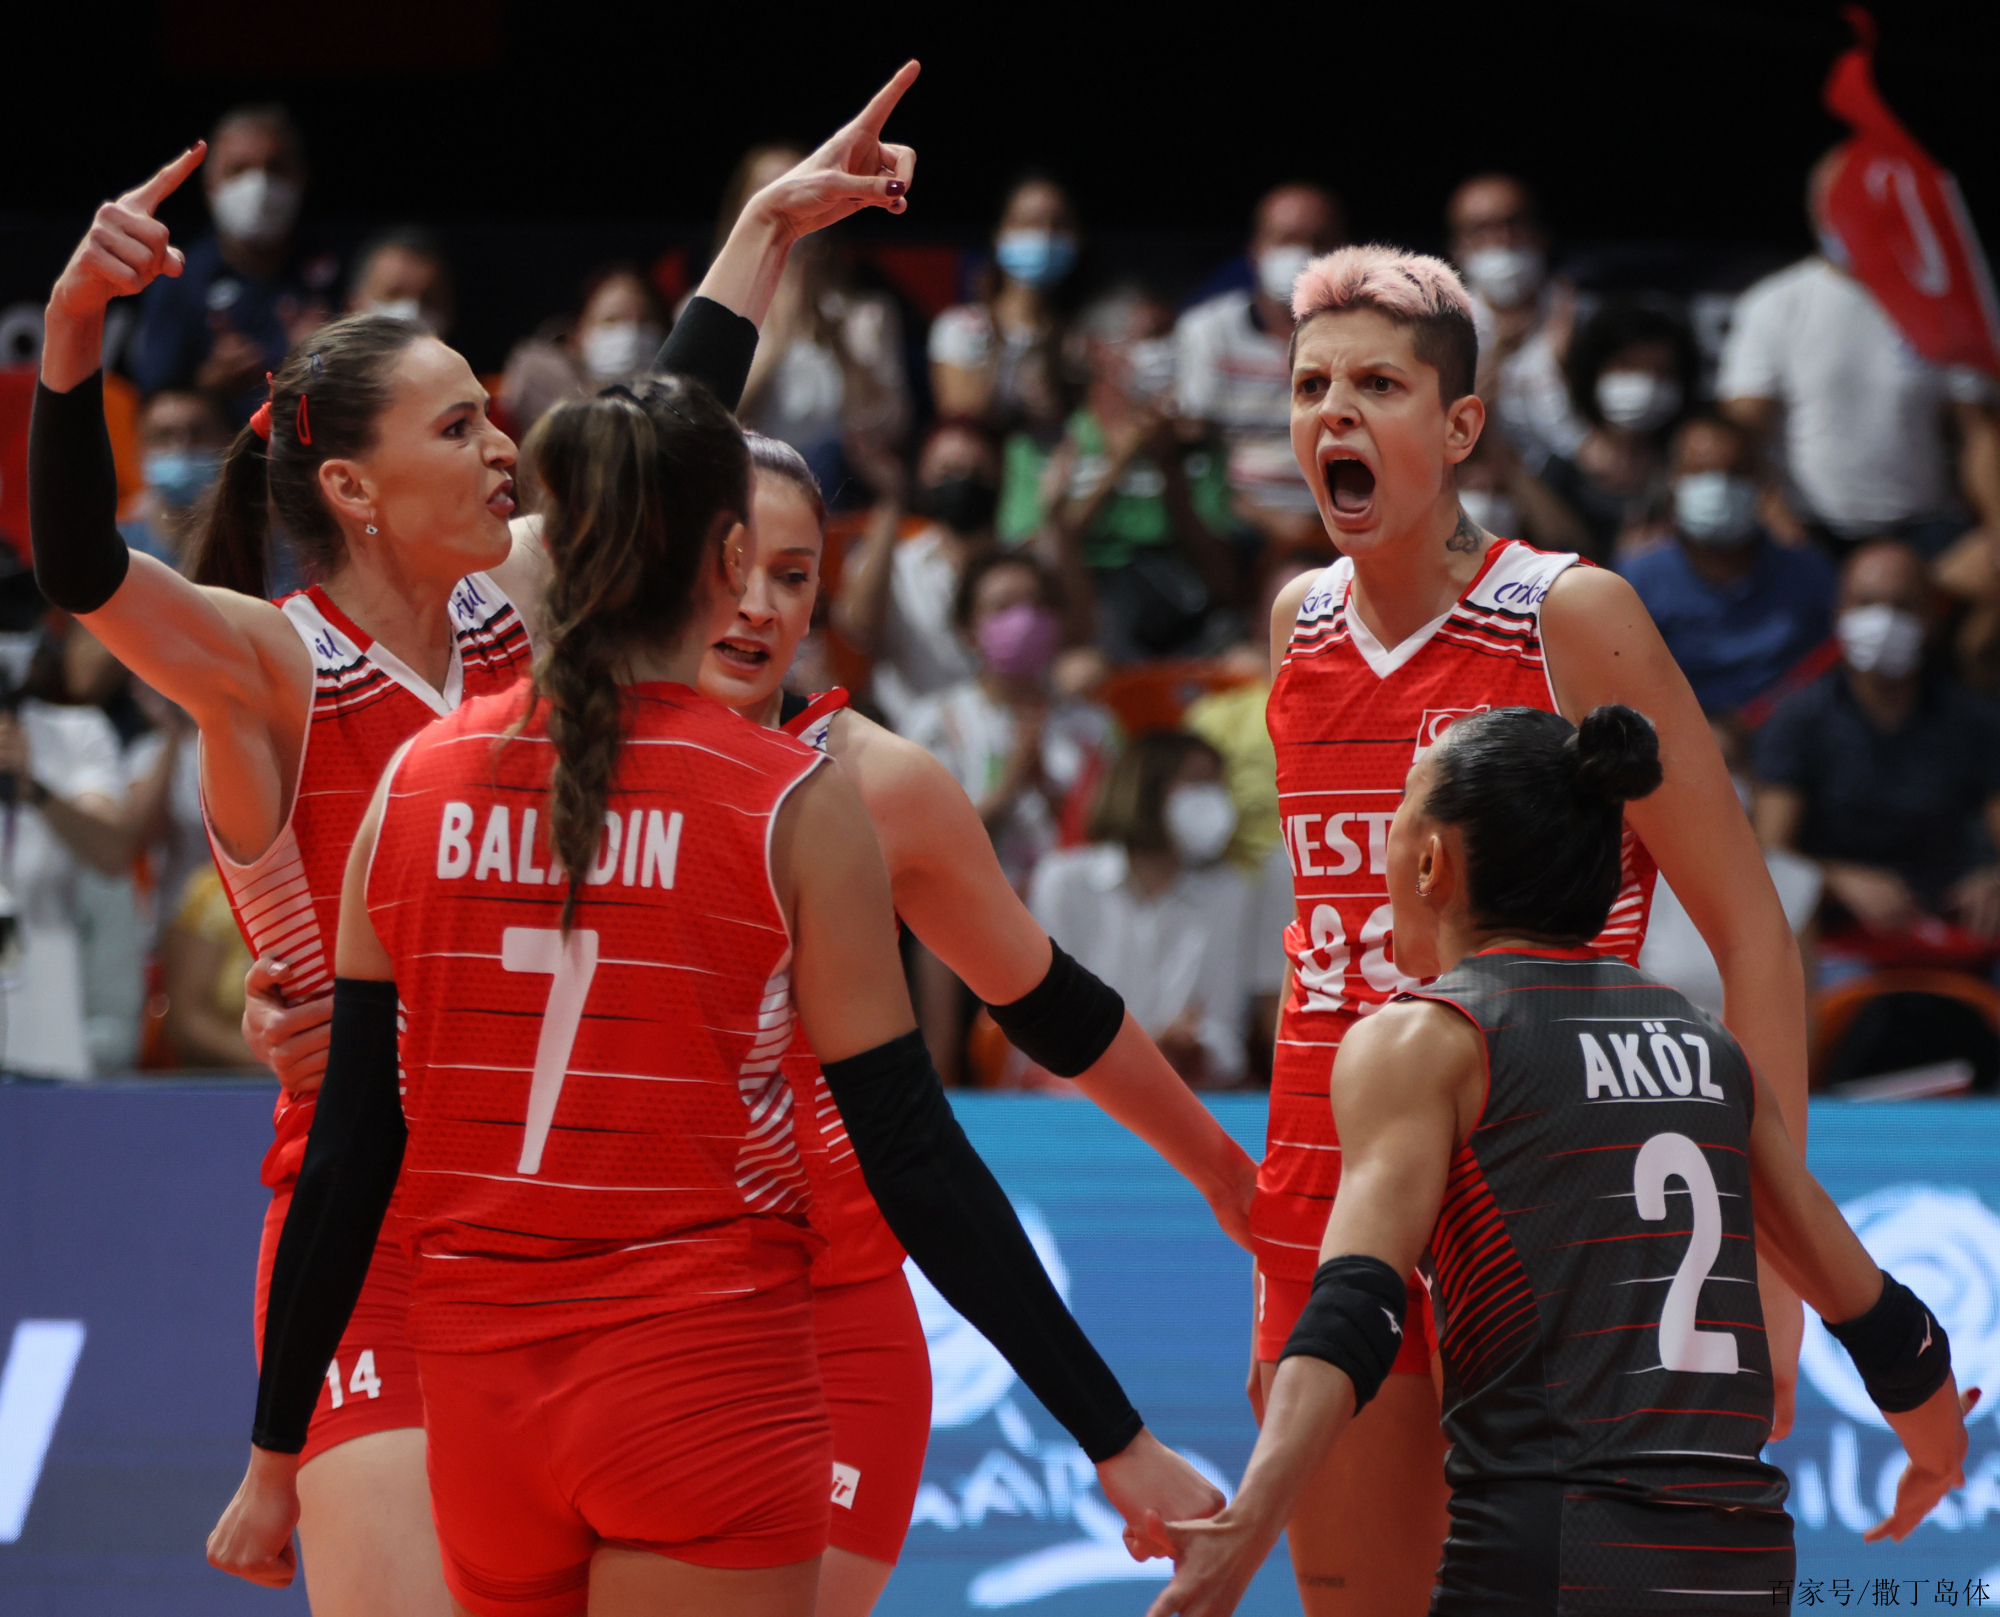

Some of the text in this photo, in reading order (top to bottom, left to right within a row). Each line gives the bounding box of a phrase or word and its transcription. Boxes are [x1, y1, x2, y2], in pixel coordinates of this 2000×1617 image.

[437, 801, 684, 890] BALDIN
[502, 926, 599, 1175] 7
[1578, 1021, 1725, 1101] AKÖZ
[1633, 1131, 1739, 1375] 2
[326, 1348, 383, 1410] 14
